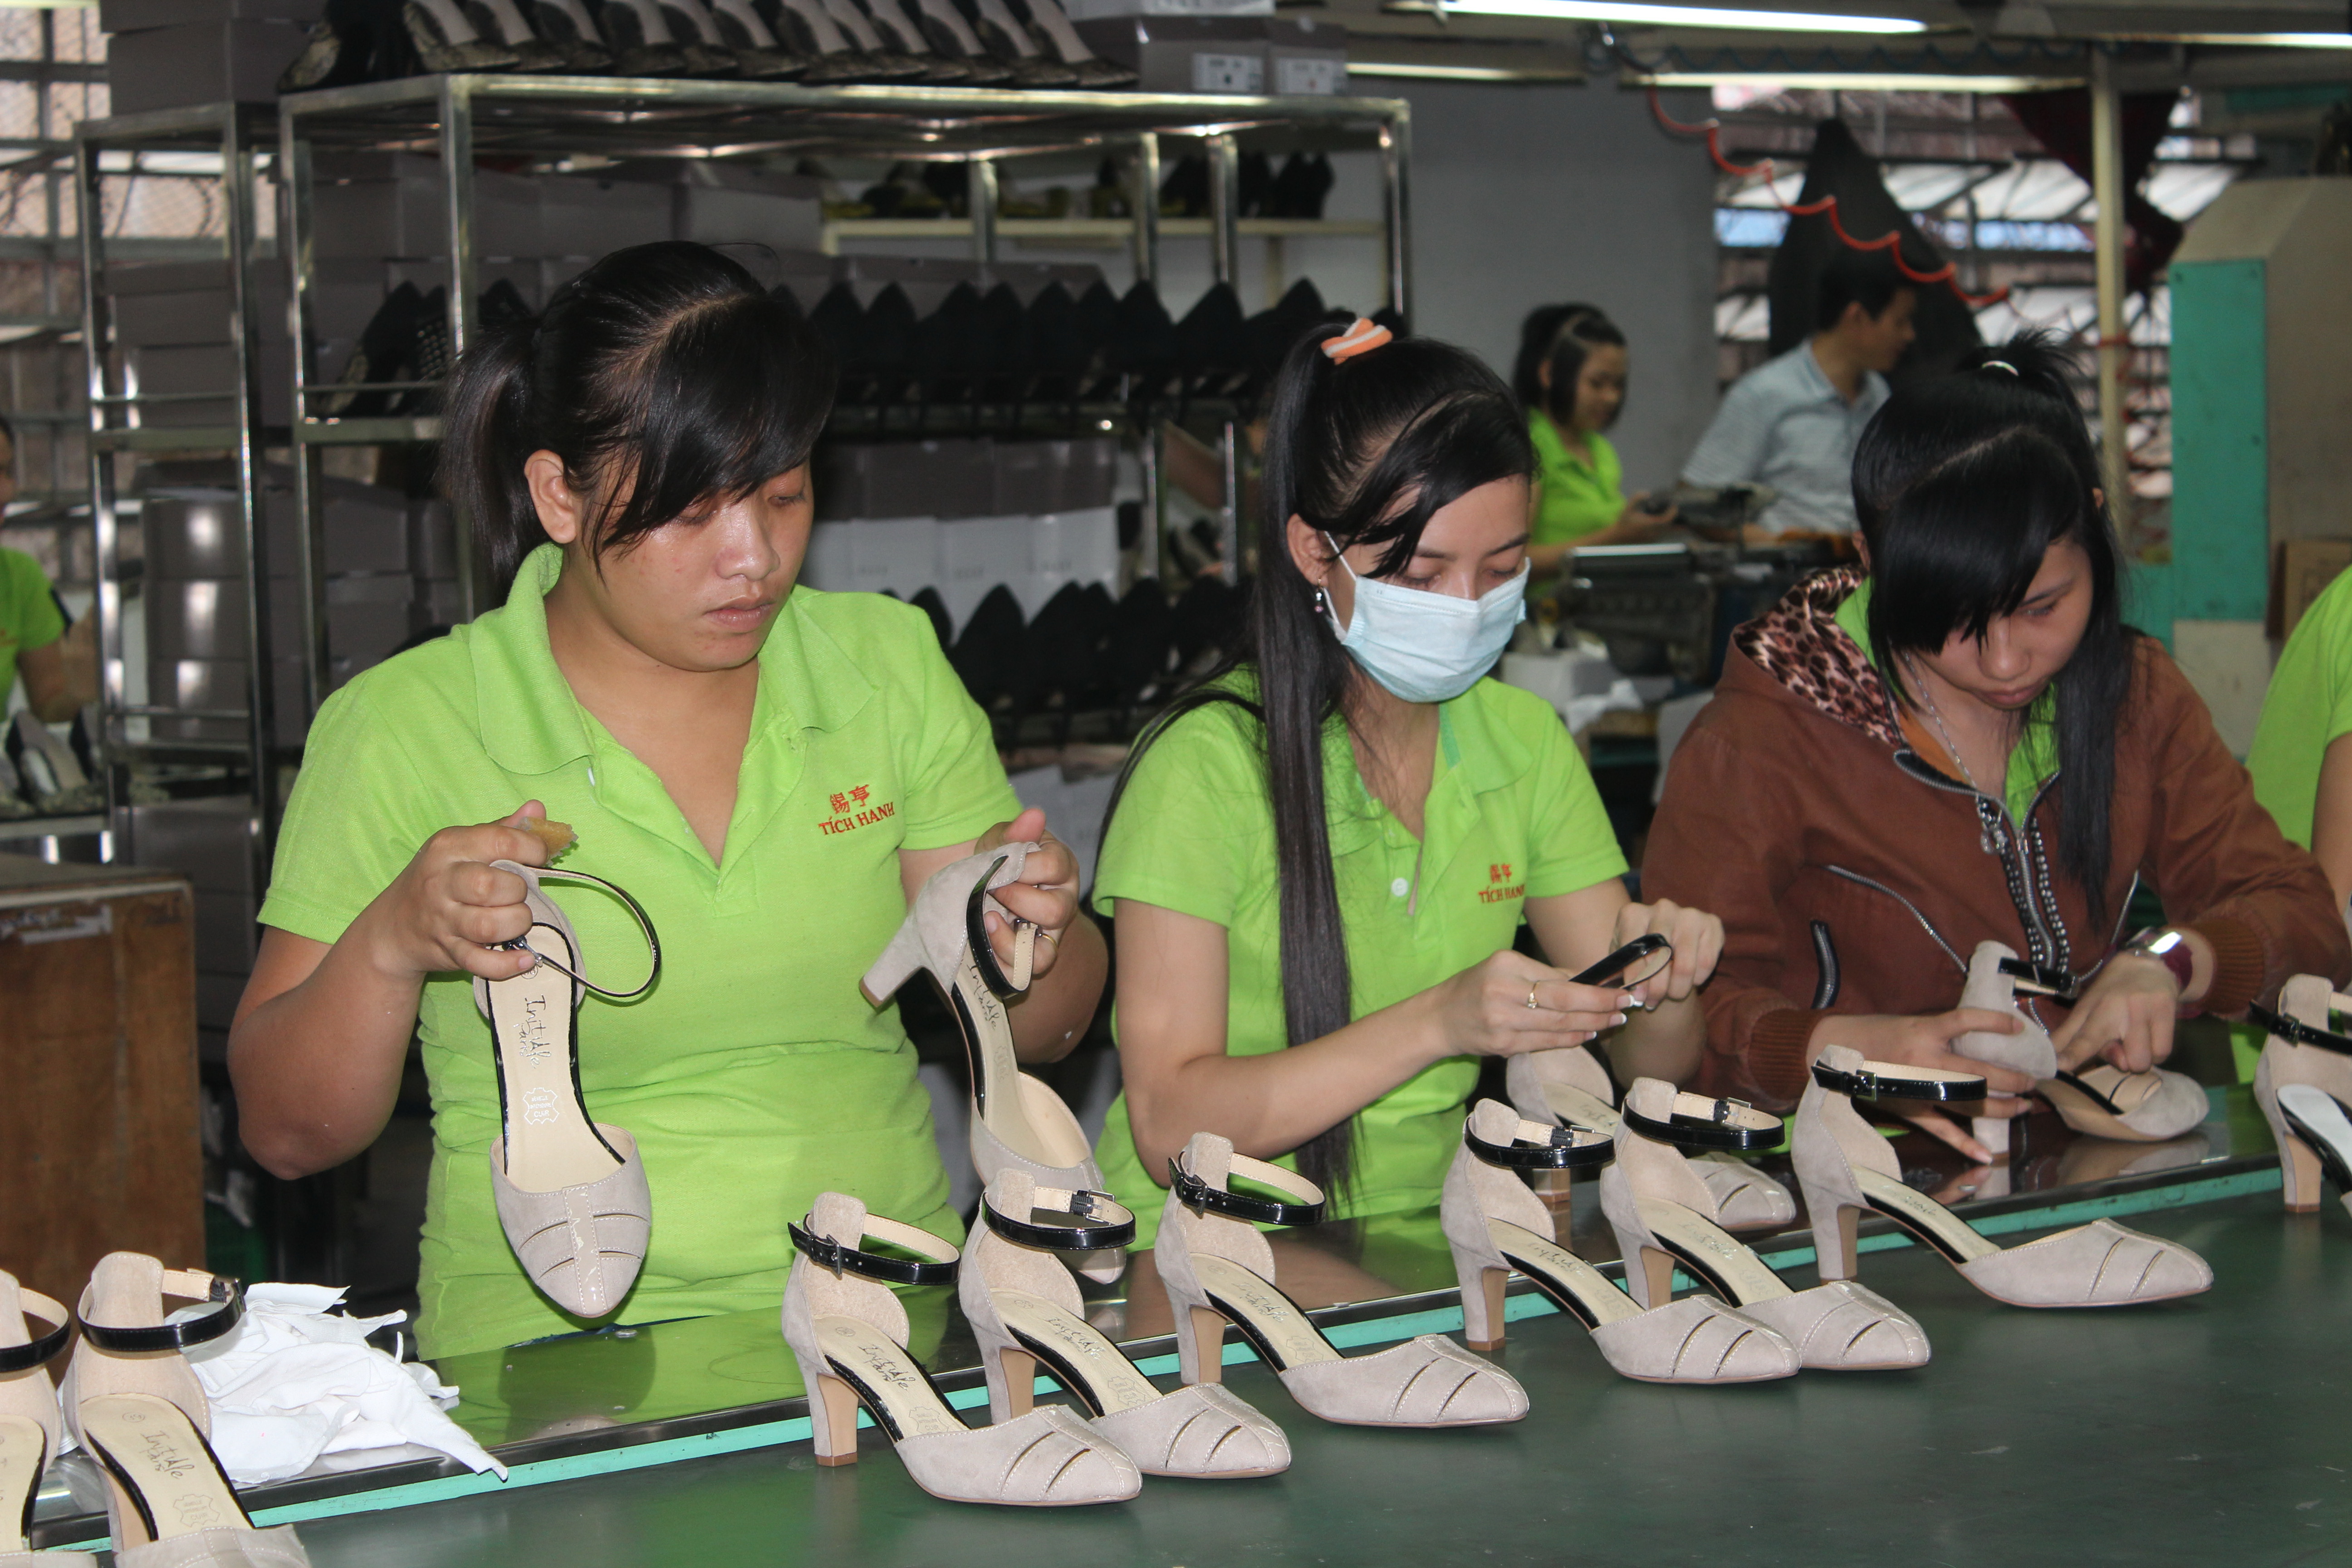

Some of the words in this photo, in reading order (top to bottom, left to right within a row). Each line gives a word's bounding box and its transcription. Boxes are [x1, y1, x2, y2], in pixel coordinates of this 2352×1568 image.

[818, 816, 856, 835] TÍCH
[855, 802, 895, 827] HANH
[1478, 885, 1504, 903] TÍCH
